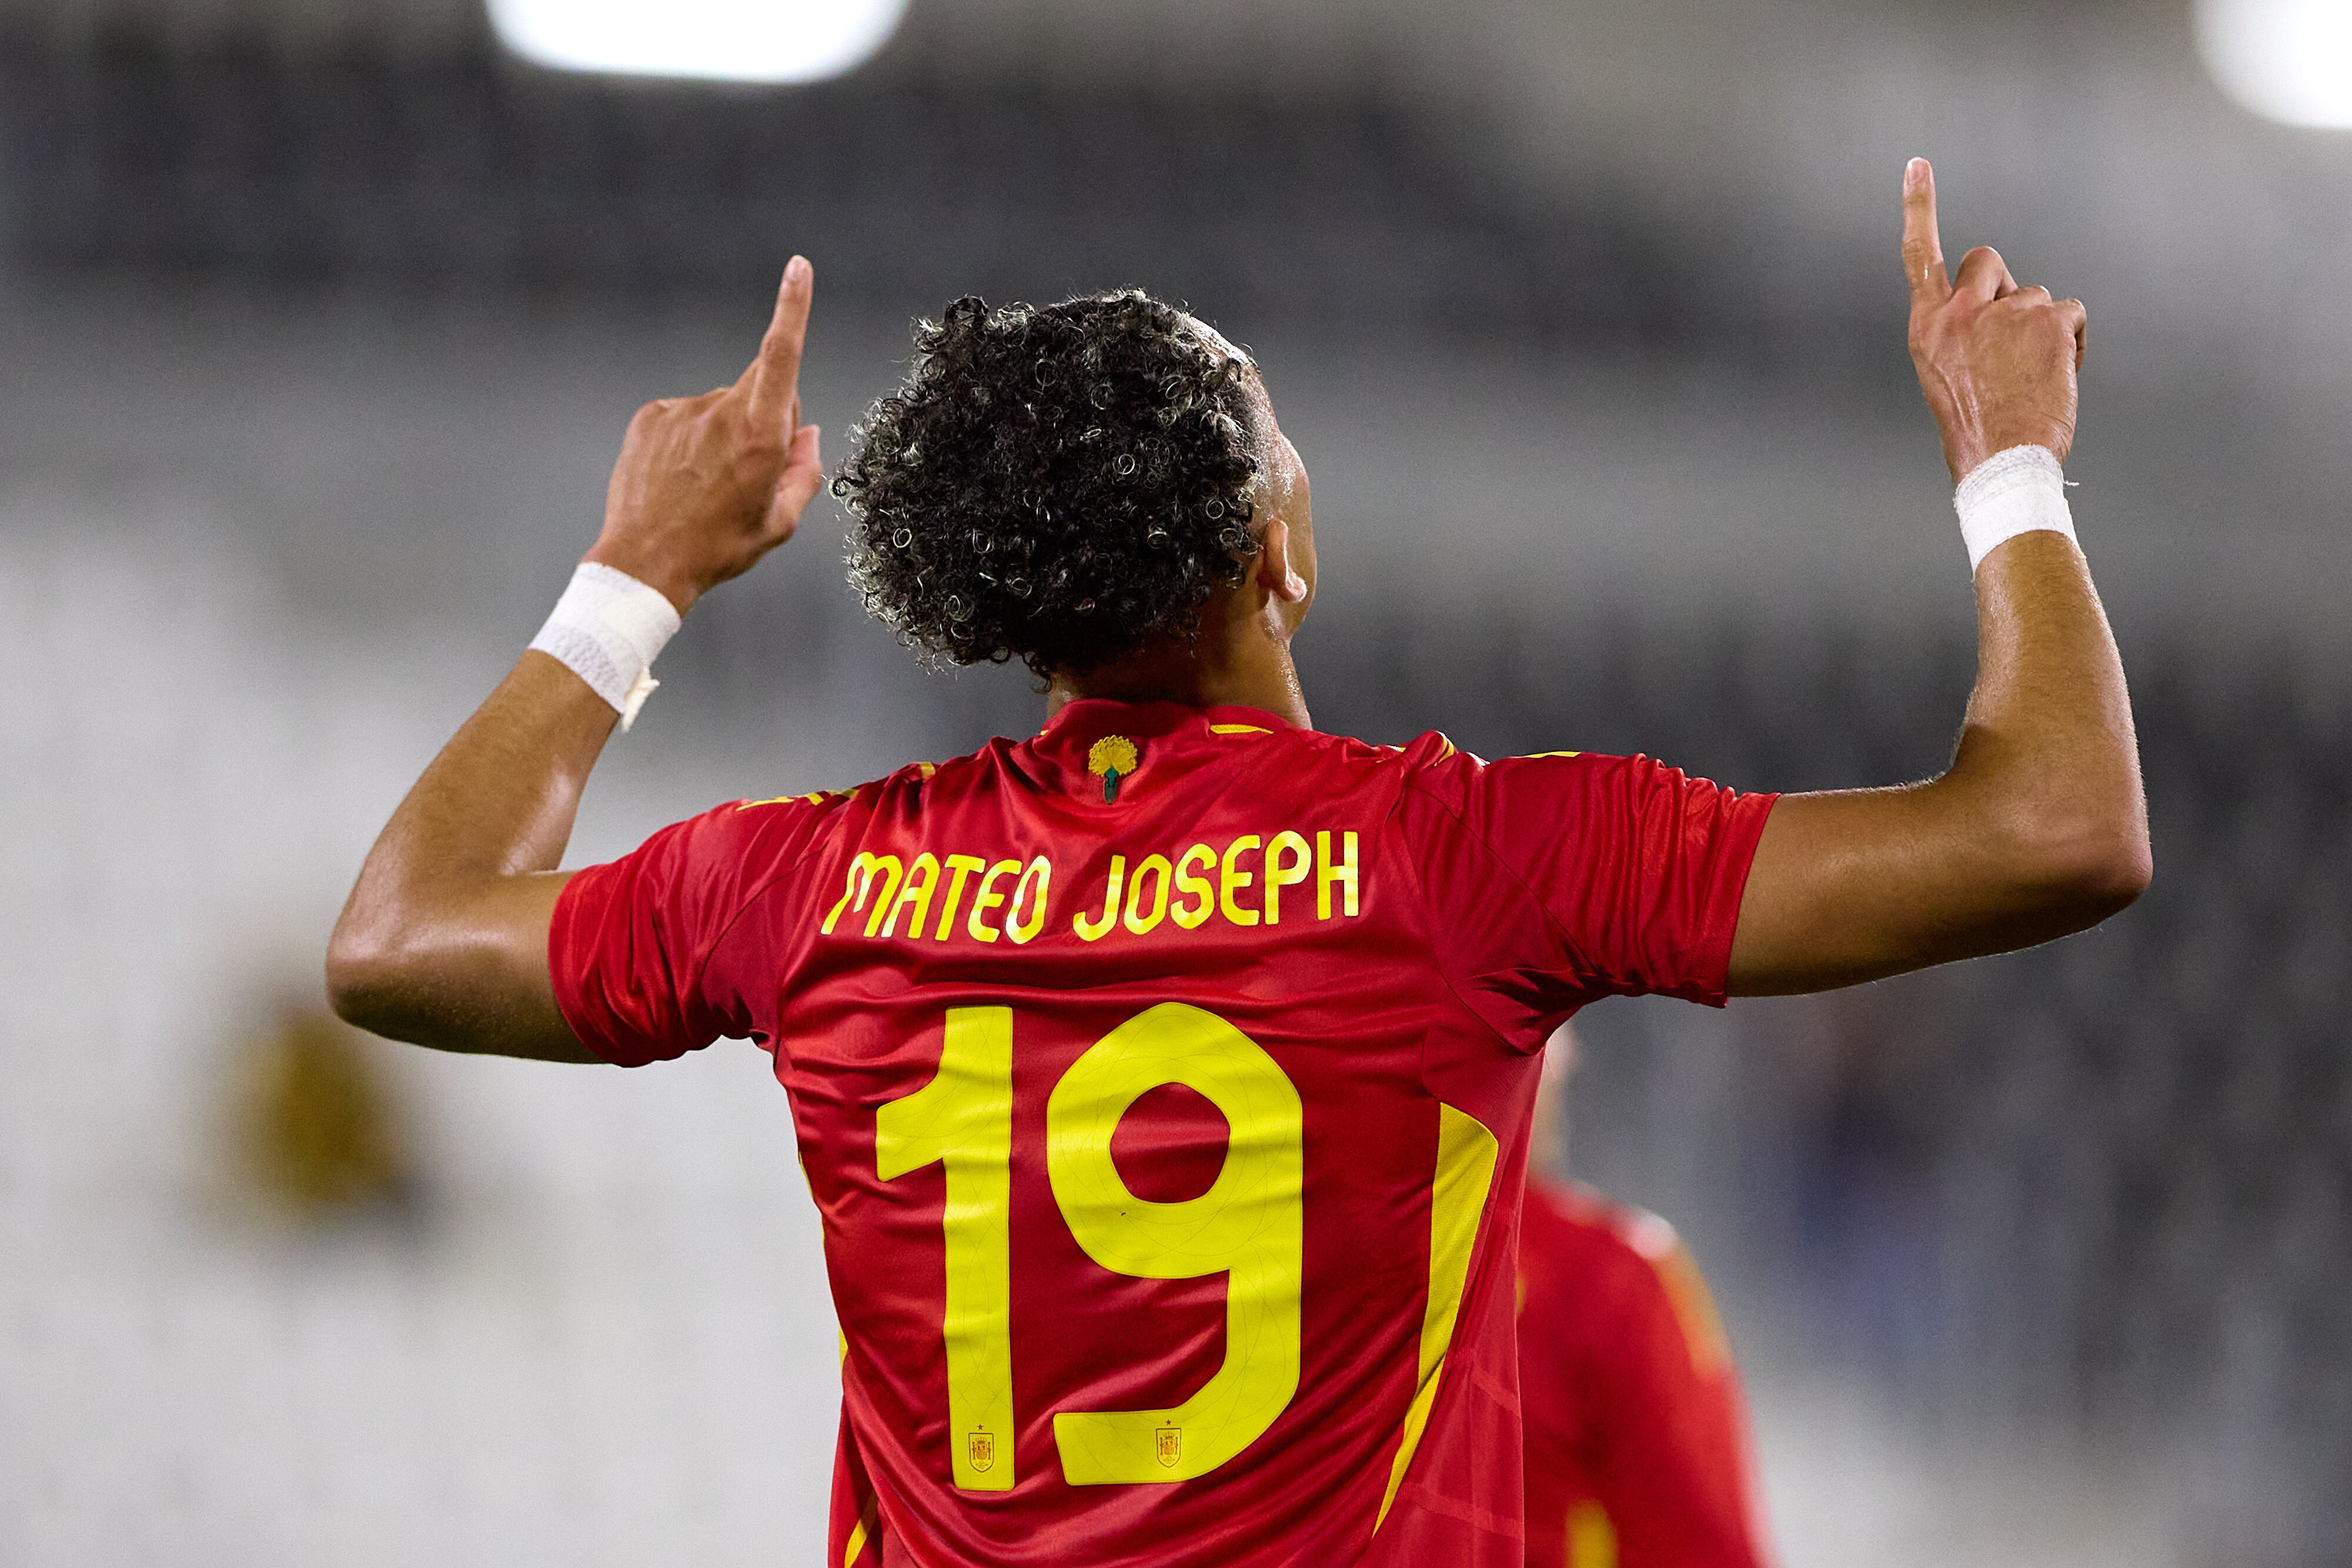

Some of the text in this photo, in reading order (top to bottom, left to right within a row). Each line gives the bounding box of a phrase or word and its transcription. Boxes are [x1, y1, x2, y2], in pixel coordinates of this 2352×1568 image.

[821, 830, 1359, 944] MATEO JOSEPH
[876, 1001, 1304, 1492] 19
